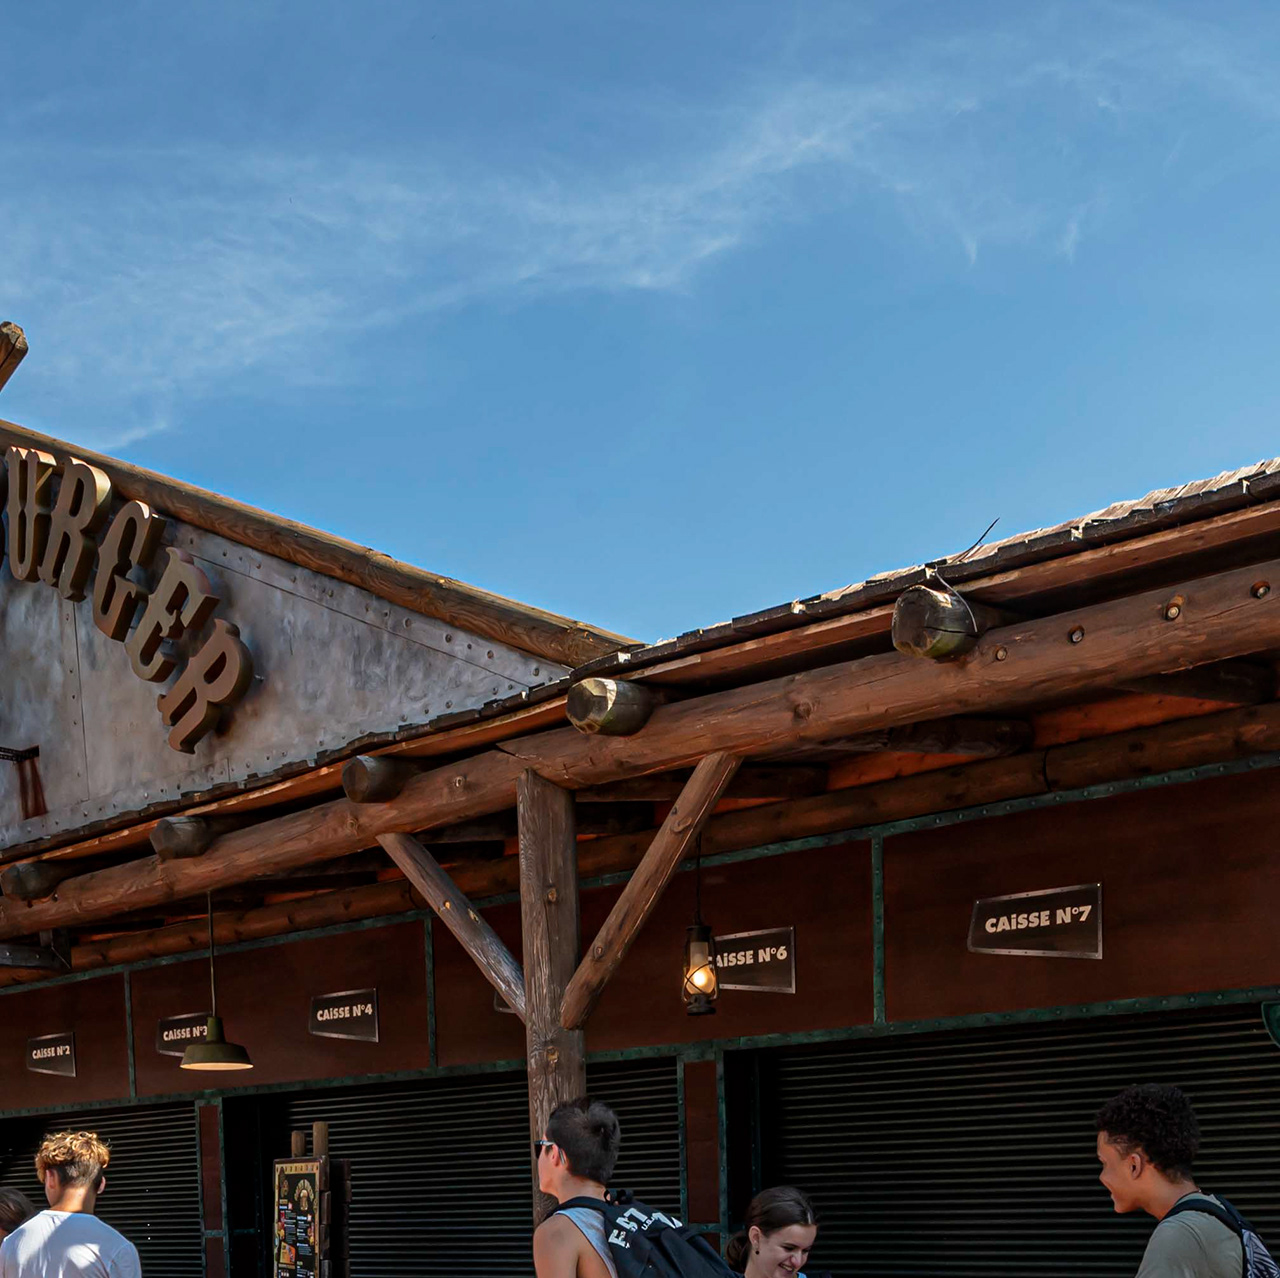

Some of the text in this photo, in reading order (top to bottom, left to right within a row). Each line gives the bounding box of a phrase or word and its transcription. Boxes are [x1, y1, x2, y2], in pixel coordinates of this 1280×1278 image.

[1056, 904, 1092, 925] N°7
[758, 945, 787, 963] N°6
[352, 1003, 373, 1017] N°4
[57, 1045, 71, 1056] N°2
